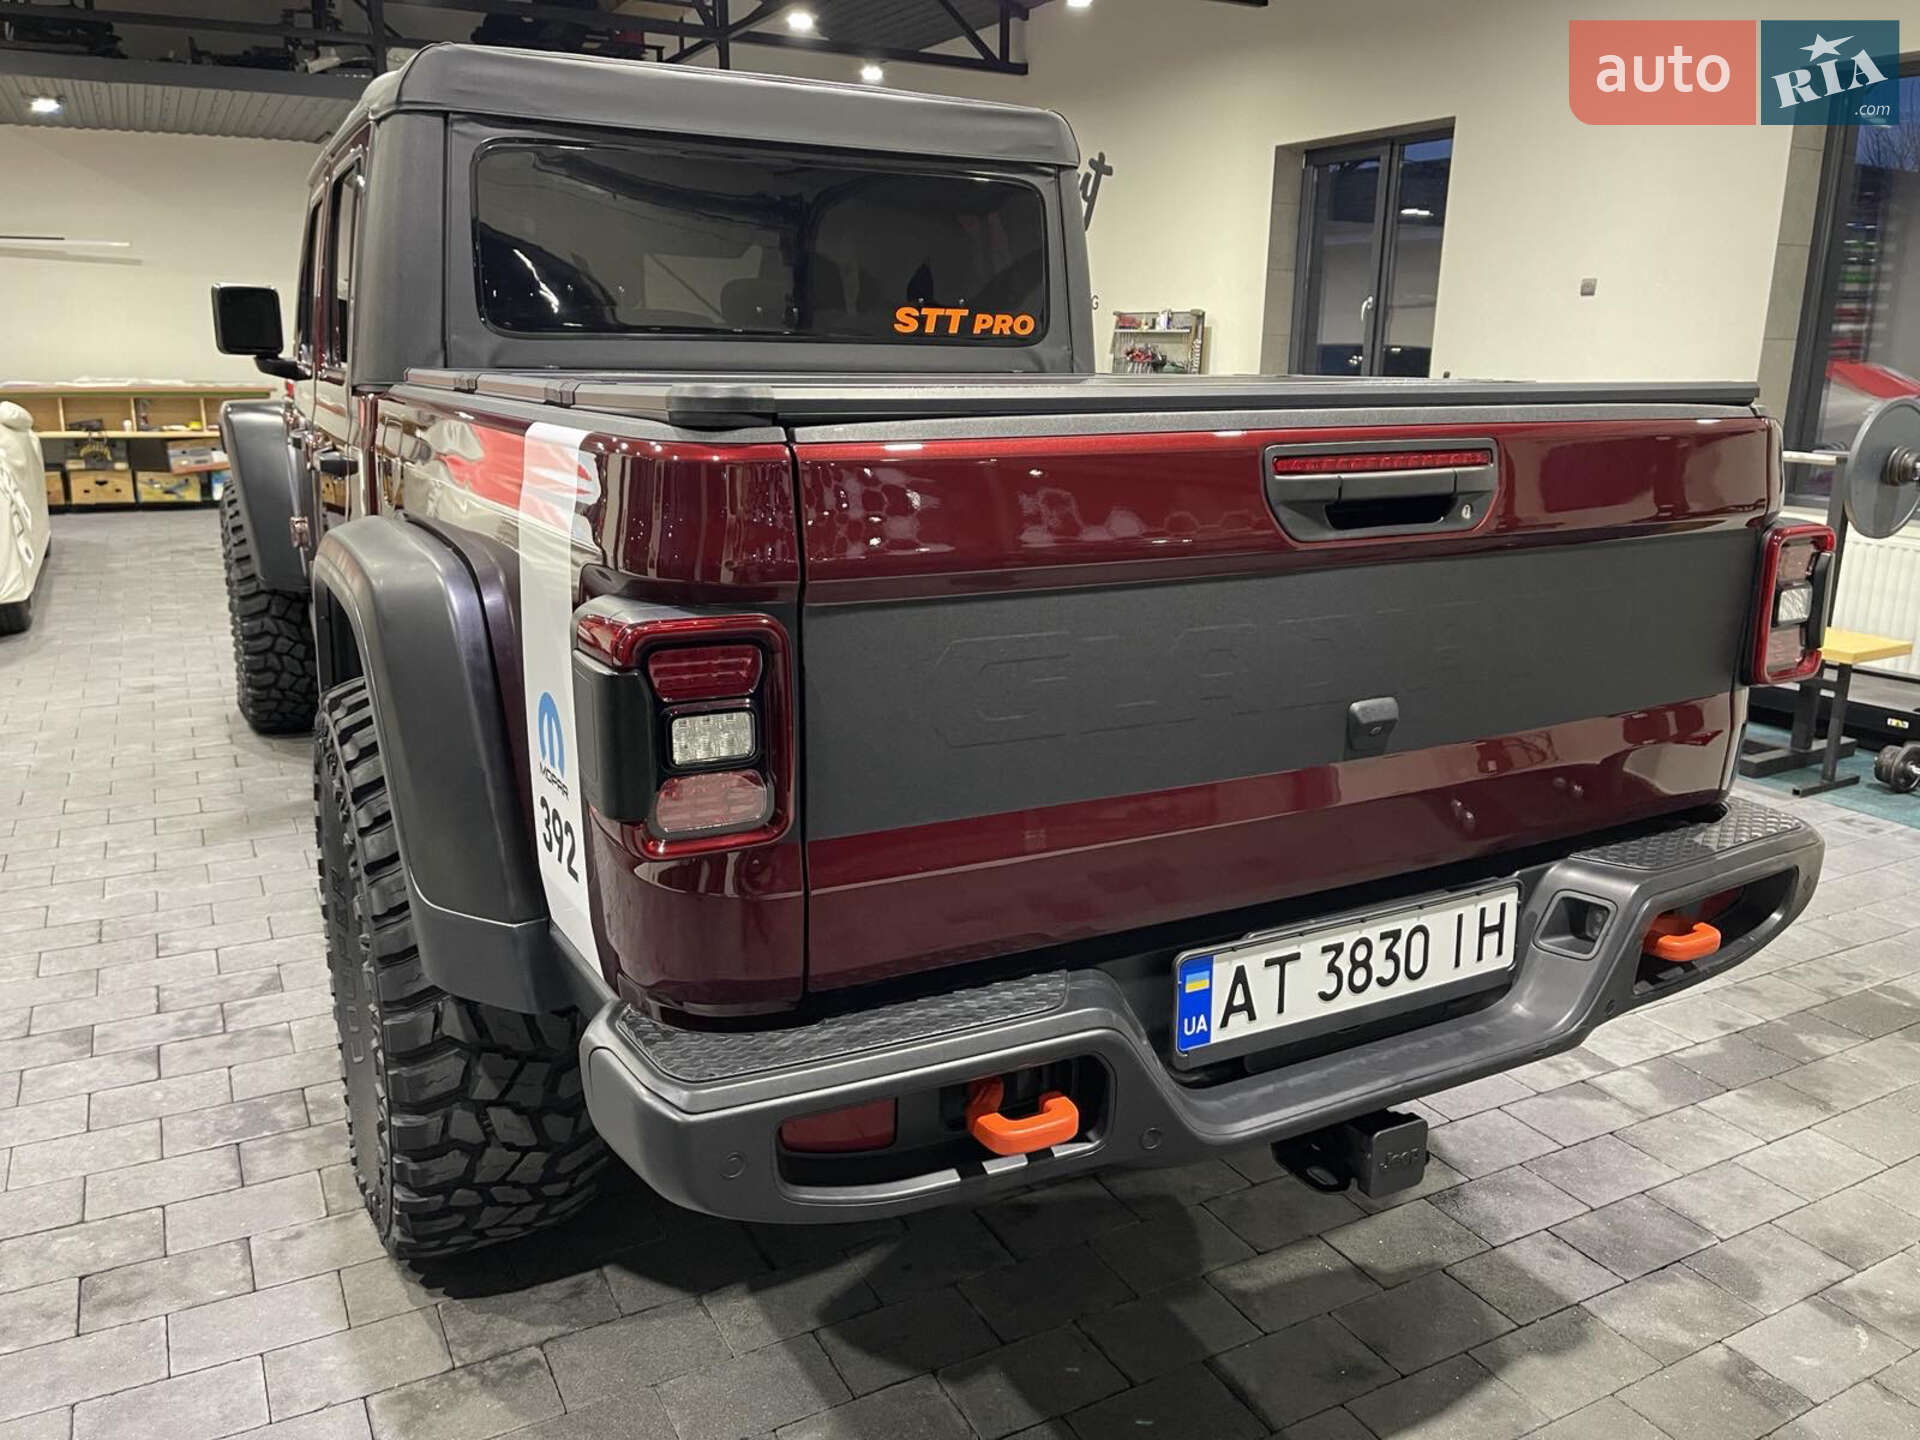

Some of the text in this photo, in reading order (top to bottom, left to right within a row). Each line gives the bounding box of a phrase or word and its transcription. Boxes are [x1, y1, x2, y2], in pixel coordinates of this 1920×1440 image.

[893, 306, 1035, 336] STT PRO
[540, 796, 579, 883] 392
[1219, 902, 1507, 1029] AT 3830 IH
[1183, 1014, 1208, 1036] UA
